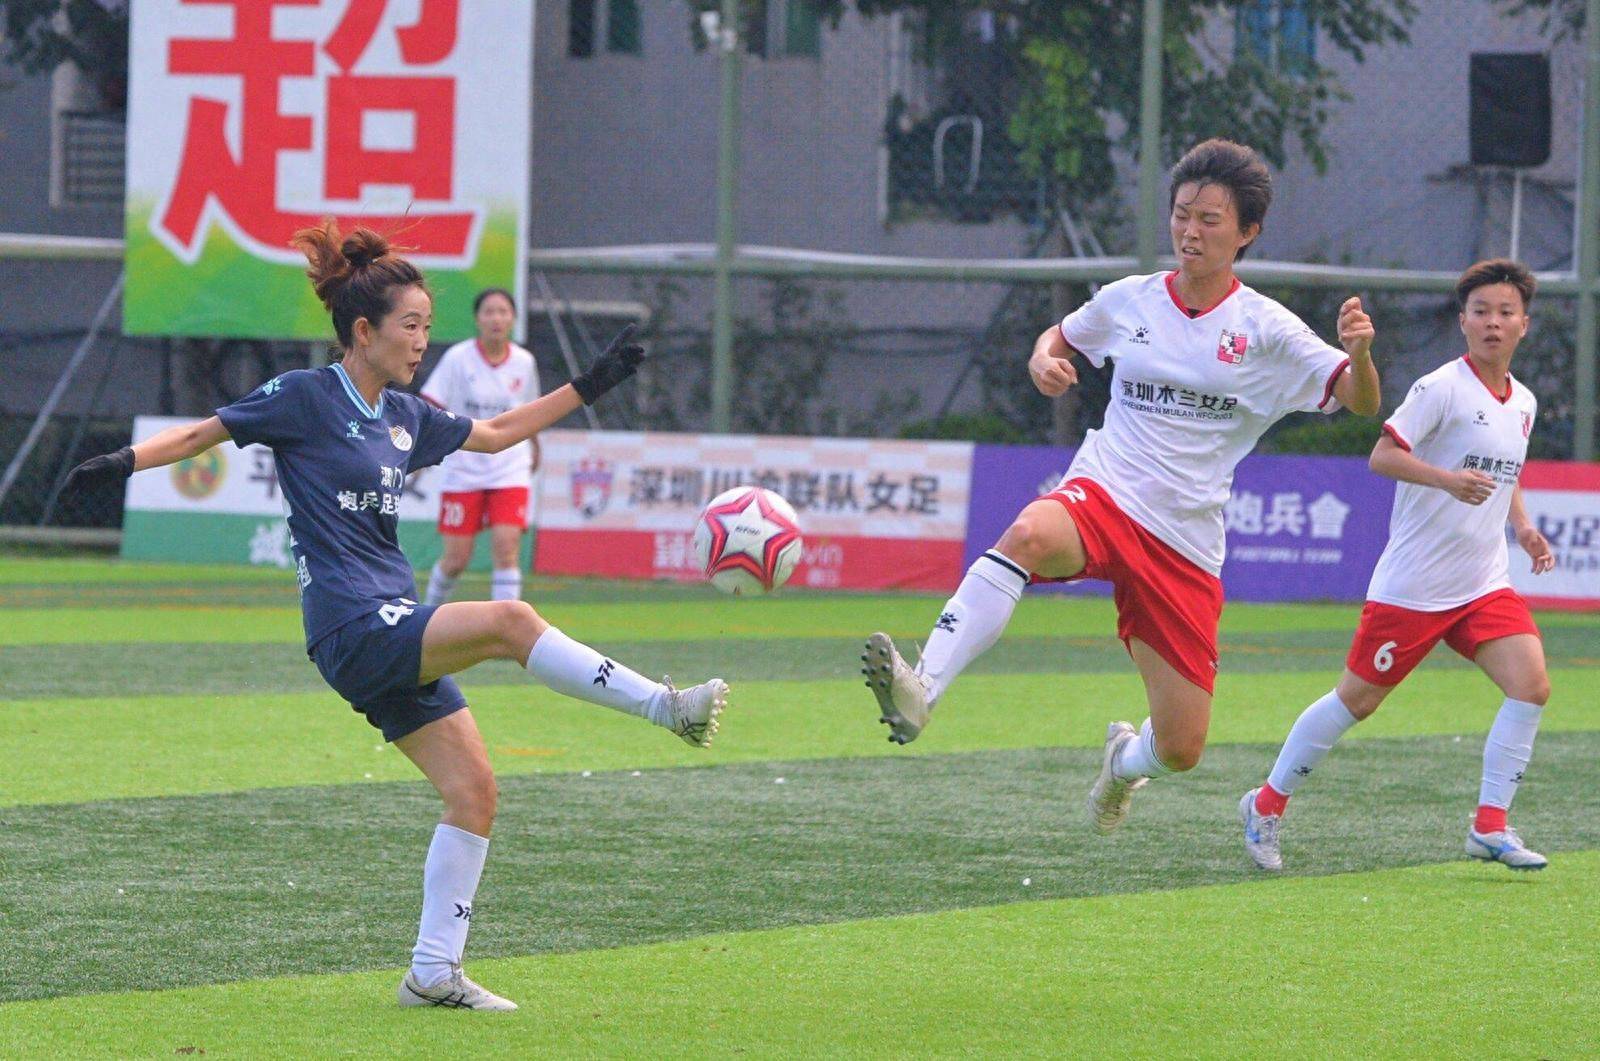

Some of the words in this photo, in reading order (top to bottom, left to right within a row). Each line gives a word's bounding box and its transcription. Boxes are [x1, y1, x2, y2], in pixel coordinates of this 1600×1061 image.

[156, 0, 478, 260] 超
[1121, 380, 1238, 412] 深圳木兰女足
[1162, 407, 1194, 418] MULAN
[1373, 641, 1398, 672] 6
